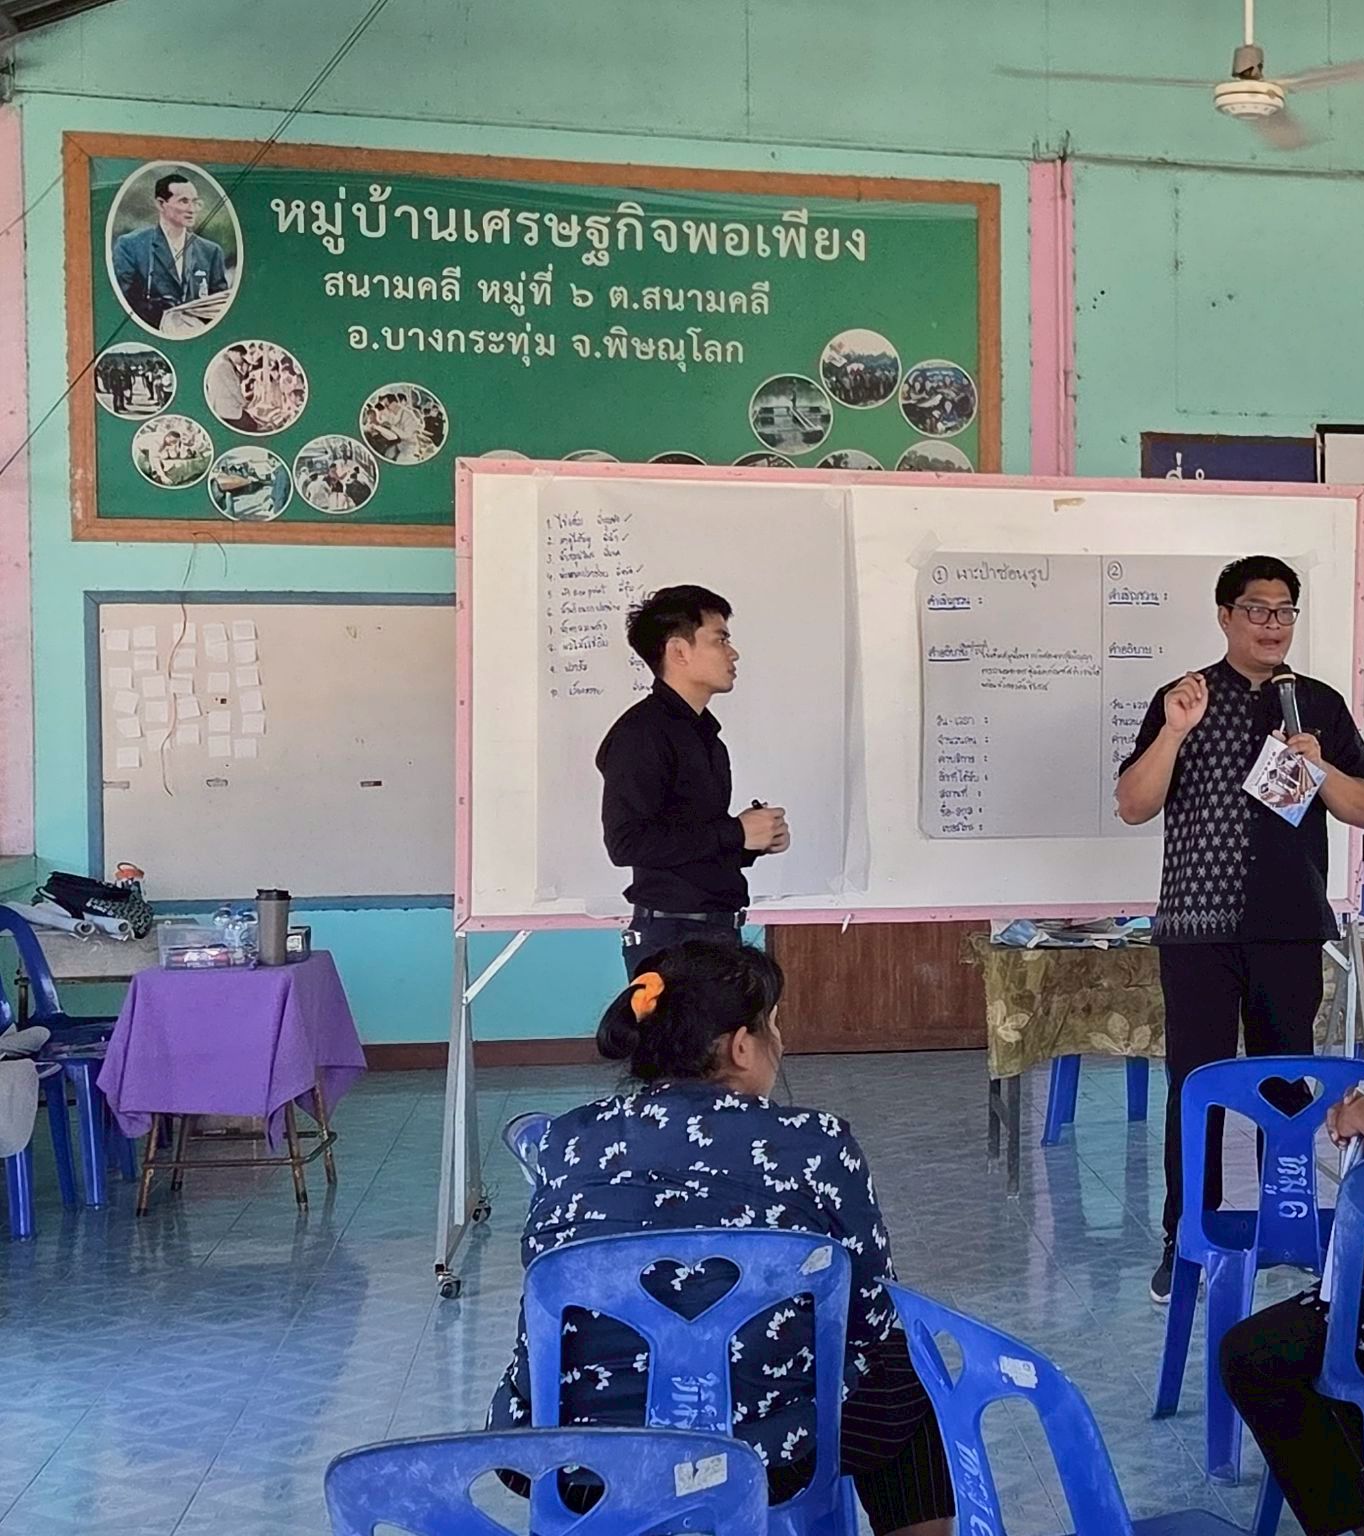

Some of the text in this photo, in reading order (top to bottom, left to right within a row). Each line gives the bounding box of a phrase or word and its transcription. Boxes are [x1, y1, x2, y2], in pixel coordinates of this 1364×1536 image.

[270, 183, 867, 267] หมู่บ้านเศรษฐกิจพอเพียง
[323, 263, 771, 317] สนามคลี หมู่ที่ ๖ ต.สนามคลี
[347, 322, 745, 374] อ.บางกระทุ่ม จ.พิษณุโลก
[1278, 1201, 1309, 1219] 6
